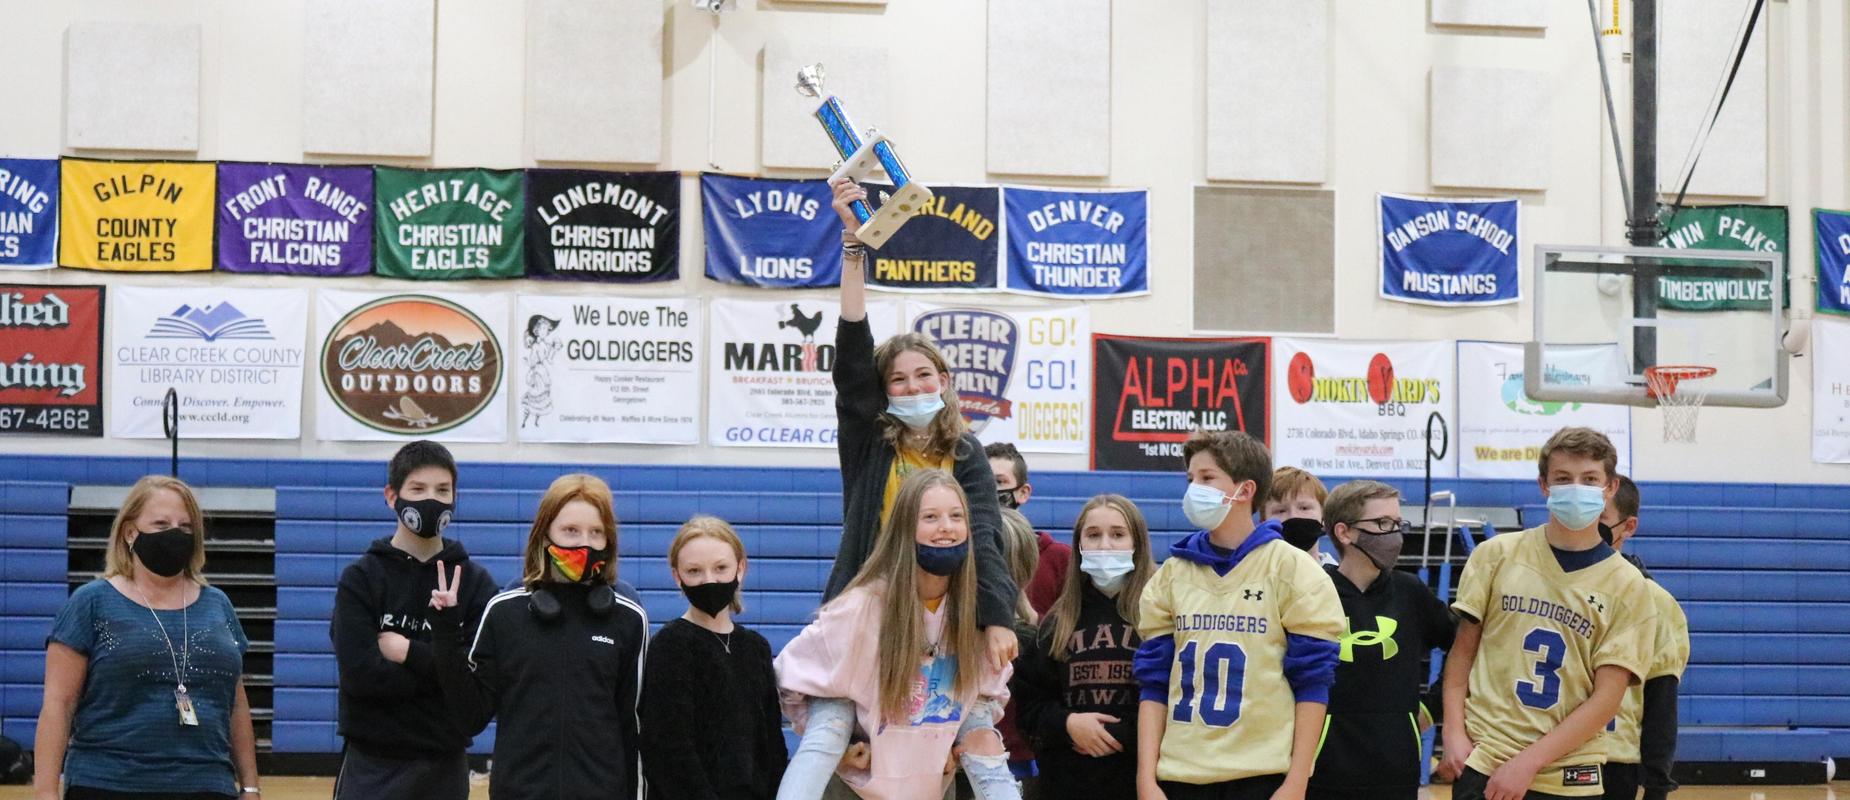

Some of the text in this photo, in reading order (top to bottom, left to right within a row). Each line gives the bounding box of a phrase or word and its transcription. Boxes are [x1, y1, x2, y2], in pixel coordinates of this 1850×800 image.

[94, 174, 183, 204] GILPIN
[225, 174, 367, 224] FRONT RANGE
[389, 179, 512, 222] HERITAGE
[537, 182, 669, 226] LONGMONT
[735, 190, 819, 221] LYONS
[97, 218, 177, 238] COUNTY
[913, 195, 994, 241] RLAND
[1027, 200, 1125, 234] DENVER
[243, 217, 349, 242] CHRISTIAN
[399, 224, 502, 246] CHRISTIAN
[550, 225, 655, 249] CHRISTIAN
[1387, 210, 1516, 256] DAWSON SCHOOL
[1658, 215, 1778, 253] TWIN PEAKS
[97, 242, 175, 261] EAGLES
[250, 242, 341, 266] FALCONS
[411, 248, 490, 270] EAGLES
[553, 249, 652, 273] WARRIORS
[1027, 242, 1125, 265] CHRISTIAN
[740, 256, 813, 279] LIONS
[875, 258, 976, 283] PANTHERS
[1032, 265, 1121, 288] THUNDER
[1403, 271, 1497, 295] MUSTANGS
[573, 305, 688, 327] We Love The
[921, 314, 1010, 344] CLEAR
[1028, 317, 1076, 346] GO!
[117, 347, 302, 364] CLEAR CREEK COUNTY
[567, 339, 693, 363] GOLDIGGERS
[938, 343, 1008, 375] REEK
[140, 368, 279, 385] LIBRARY DISTRICT
[341, 374, 482, 394] OUTDOORS
[732, 376, 783, 385] BREAKFAST
[1027, 360, 1076, 390] GO!
[1117, 356, 1241, 409] ALPHA
[183, 396, 229, 408] Discover.
[234, 397, 286, 410] Empower.
[1378, 404, 1406, 417] BBQ
[0, 408, 89, 430] 67-4262
[1018, 402, 1083, 440] DIGGERS!
[1201, 411, 1227, 431] LLC
[726, 427, 753, 442] GO
[758, 428, 814, 443] CLEAR
[1305, 428, 1336, 439] Colorado
[1359, 429, 1378, 439] Idaho
[1379, 429, 1405, 441] Springs
[1159, 443, 1170, 456] IN
[1475, 447, 1498, 460] We
[1500, 449, 1522, 460] are
[1366, 460, 1390, 469] Denver
[1501, 595, 1595, 640] GOLDDIGGERS
[591, 635, 615, 645] adidas
[1073, 663, 1102, 680] EST.
[1515, 627, 1567, 711] 3
[1172, 640, 1247, 728] 10
